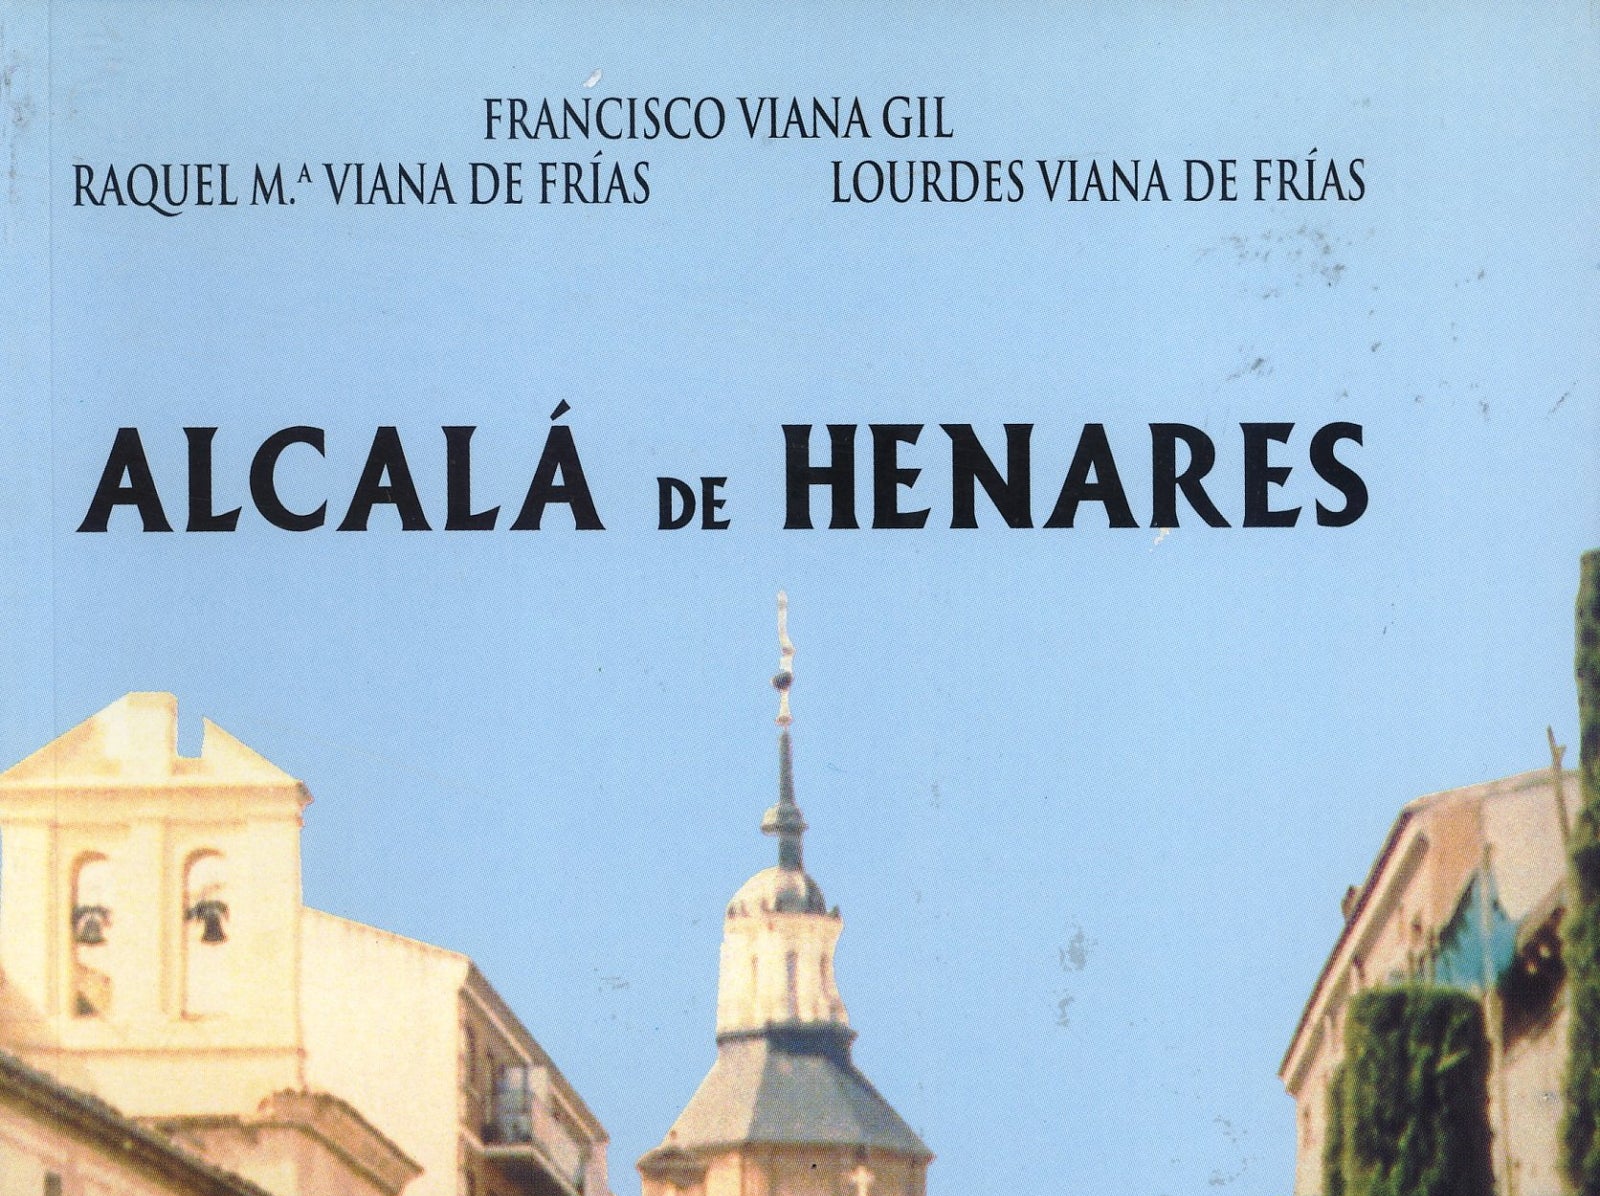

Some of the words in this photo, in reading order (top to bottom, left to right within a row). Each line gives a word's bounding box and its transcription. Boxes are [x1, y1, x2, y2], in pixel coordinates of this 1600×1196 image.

[484, 96, 726, 140] FRANCISCO
[737, 96, 871, 140] VIANA
[882, 95, 954, 139] GIL
[72, 162, 239, 217] RAQUEL
[322, 162, 457, 205] VIANA
[470, 162, 523, 205] DE
[539, 150, 651, 205] FRÍAS
[831, 160, 1024, 204] LOURDES
[1036, 159, 1172, 203] VIANA
[1183, 159, 1238, 202] DE
[1253, 147, 1366, 202] FRÍAS
[76, 398, 606, 533] ALCALÁ
[656, 476, 731, 531] DE
[781, 421, 1370, 530] HENARES
